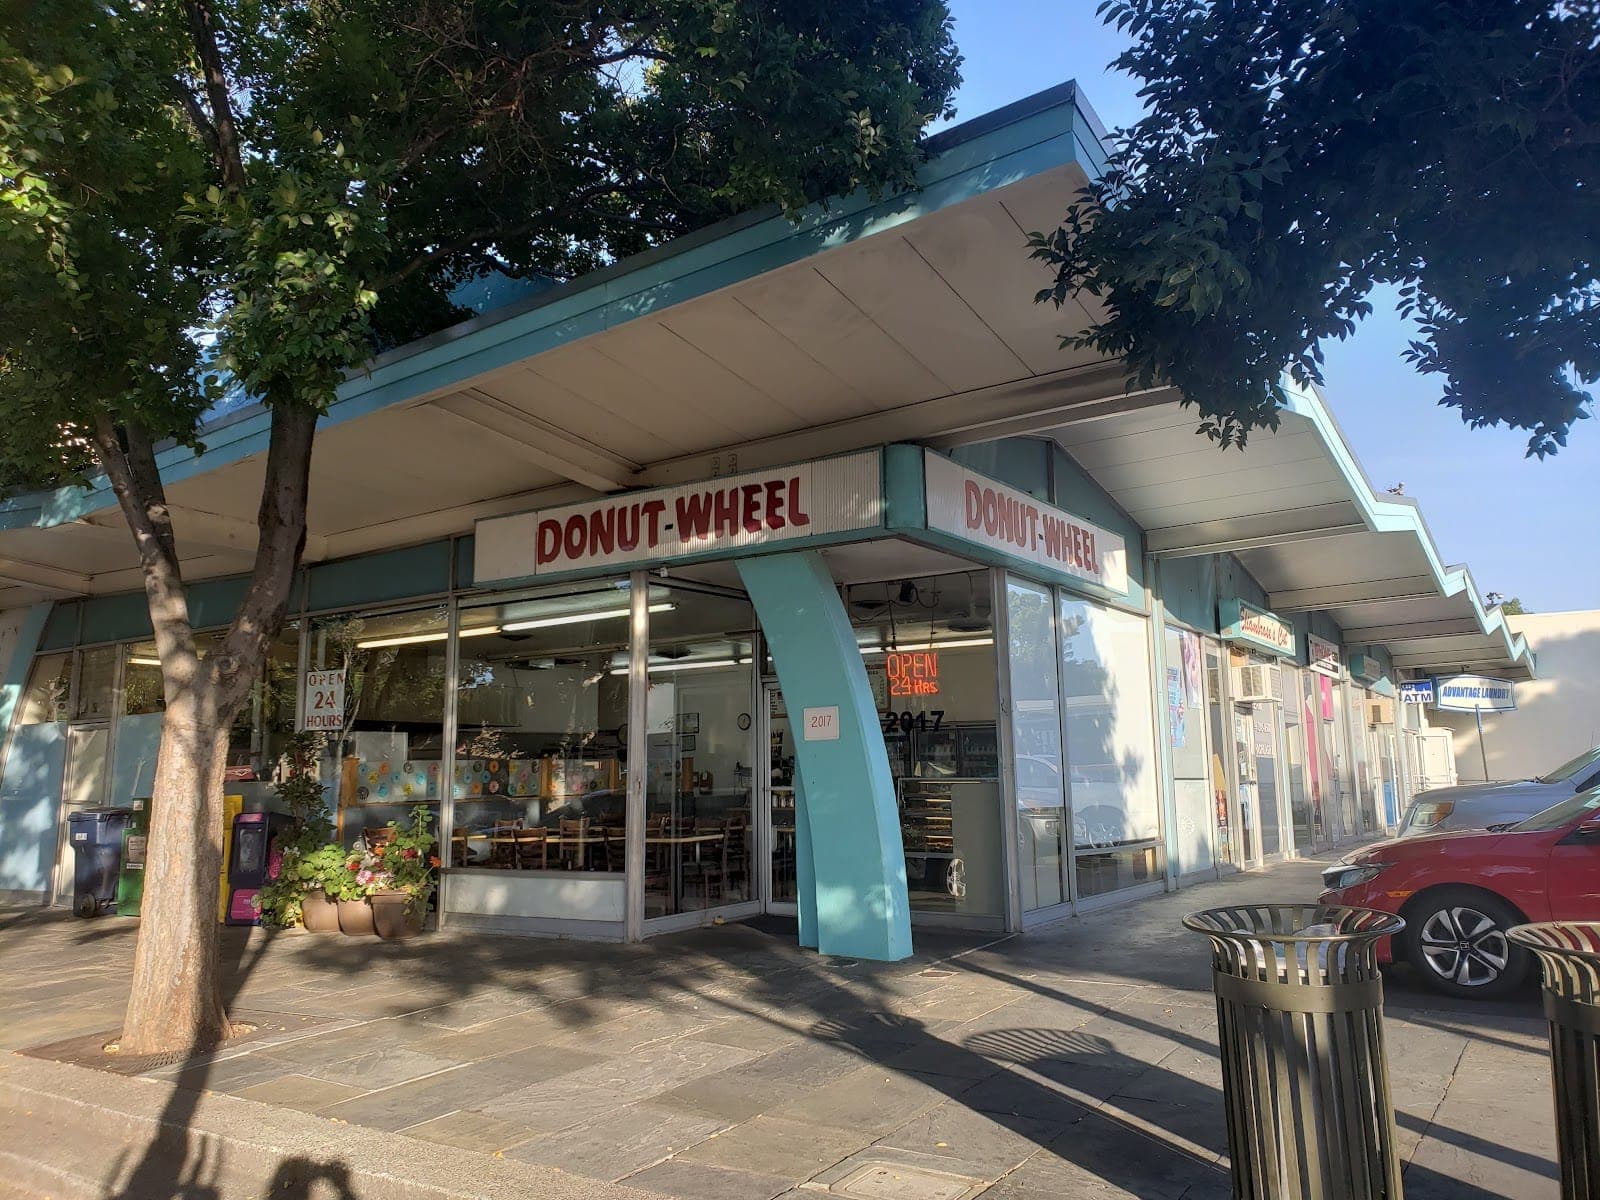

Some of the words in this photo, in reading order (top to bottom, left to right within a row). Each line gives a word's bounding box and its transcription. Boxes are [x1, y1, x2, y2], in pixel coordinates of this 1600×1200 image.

[537, 477, 810, 565] DONUT-WHEEL
[887, 652, 938, 678] OPEN
[309, 672, 346, 687] OPEN
[890, 675, 912, 696] 24
[314, 690, 336, 710] 24
[1403, 693, 1431, 703] ATM
[1442, 686, 1481, 698] ADVANTAGE
[1481, 687, 1510, 699] LAUNDRY
[306, 714, 342, 728] HOURS
[811, 714, 832, 728] 2017
[885, 710, 945, 733] 2017
